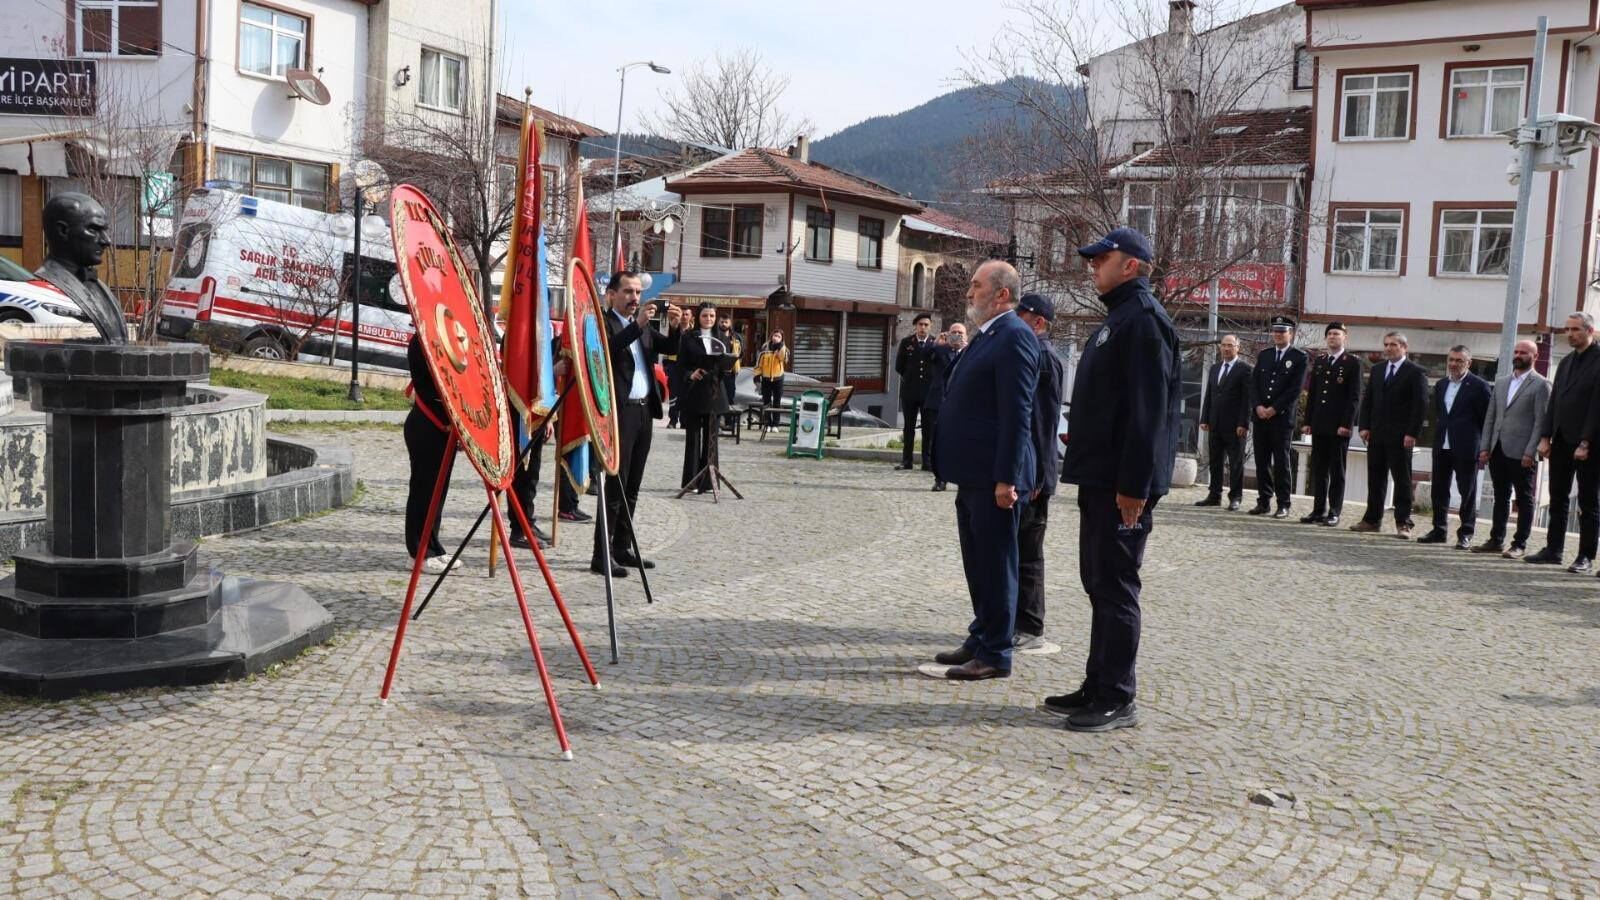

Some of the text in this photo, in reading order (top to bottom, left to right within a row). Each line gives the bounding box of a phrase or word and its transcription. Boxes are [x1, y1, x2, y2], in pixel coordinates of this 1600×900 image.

[22, 69, 90, 94] PARTİ
[15, 94, 34, 107] İLÇE
[358, 323, 408, 341] AMBULANS
